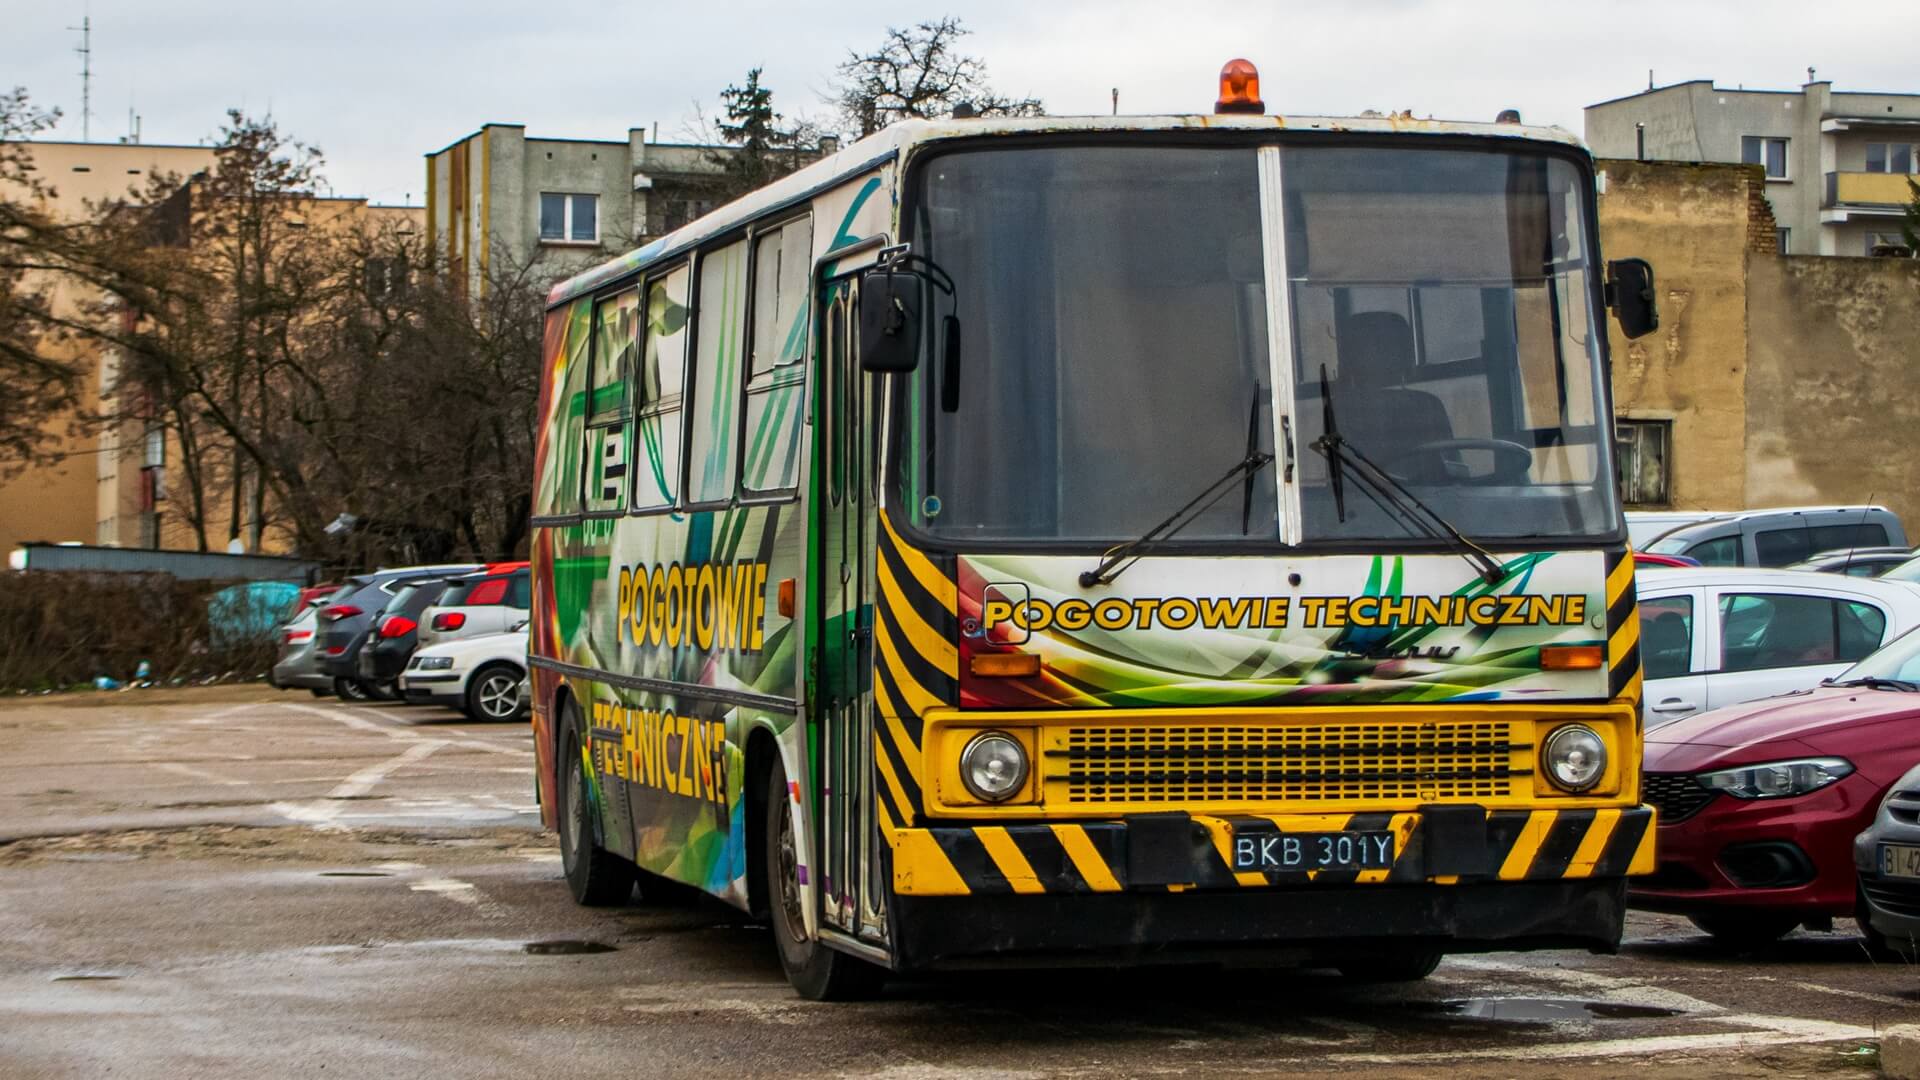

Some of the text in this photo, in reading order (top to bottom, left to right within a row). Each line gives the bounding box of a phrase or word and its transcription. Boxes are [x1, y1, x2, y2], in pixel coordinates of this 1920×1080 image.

[617, 561, 768, 655] POGOTOWIE
[983, 595, 1587, 630] POGOTOWIE TECHNICZNE
[592, 701, 727, 804] TECHNICZNE
[1236, 835, 1391, 867] BKB 301Y
